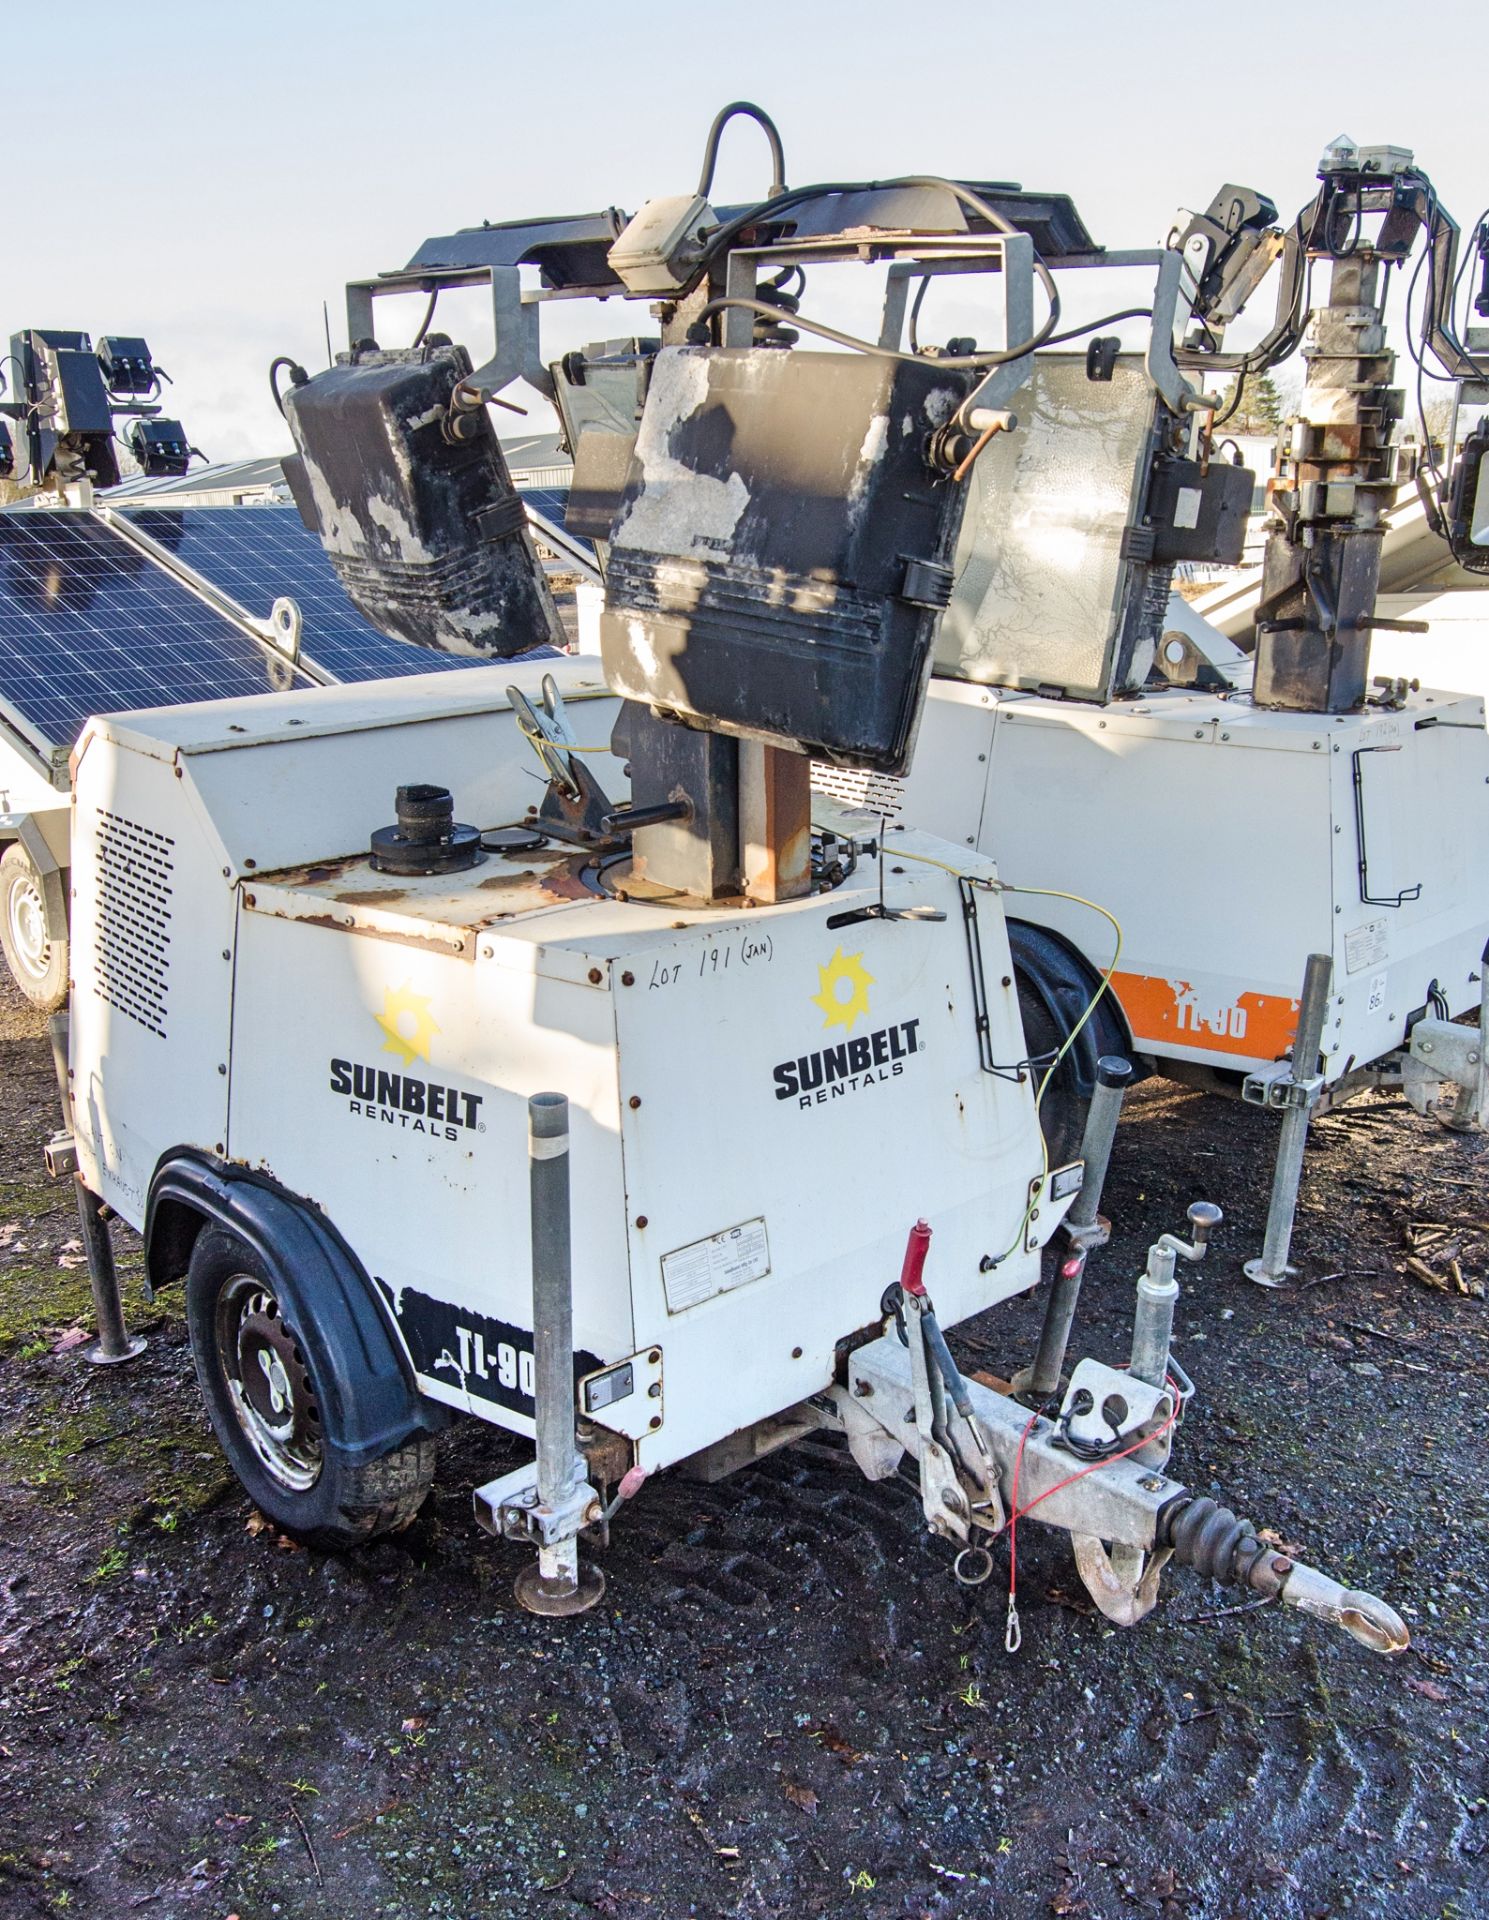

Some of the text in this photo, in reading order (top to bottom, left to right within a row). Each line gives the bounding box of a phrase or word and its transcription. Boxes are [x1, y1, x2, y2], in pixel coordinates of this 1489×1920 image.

[649, 934, 773, 990] LOT 191 (JAN)
[800, 1062, 905, 1110] RENTALS
[350, 1100, 458, 1142] RENTALS
[456, 1325, 535, 1397] TL-90
